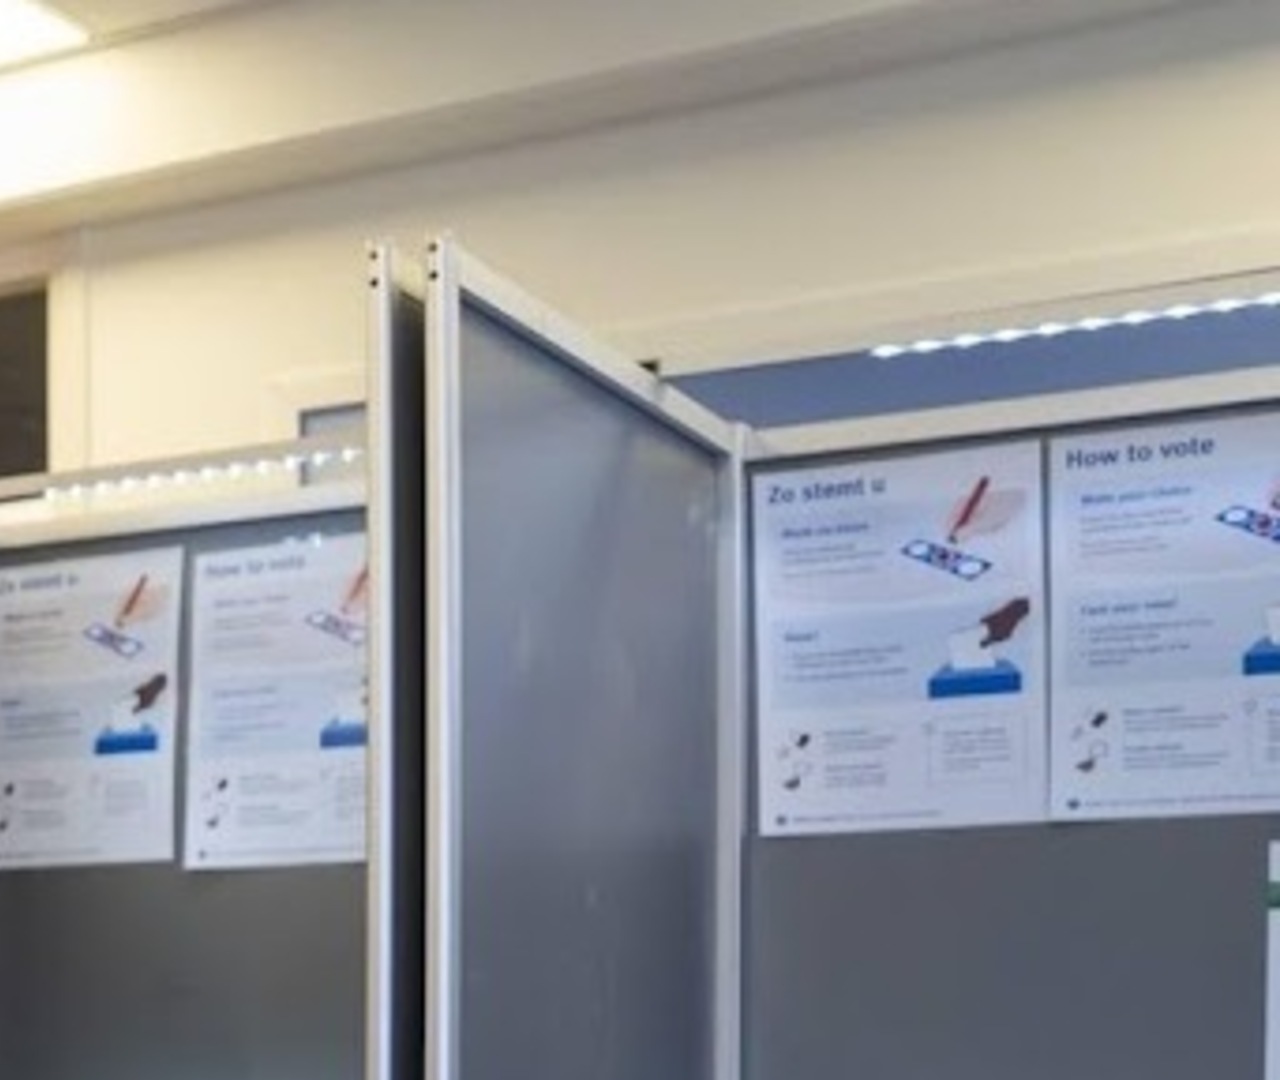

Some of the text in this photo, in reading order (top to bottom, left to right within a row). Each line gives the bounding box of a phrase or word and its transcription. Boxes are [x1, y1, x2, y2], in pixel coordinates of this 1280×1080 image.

[1065, 437, 1215, 469] How to vote
[768, 478, 886, 504] Zo stemt u
